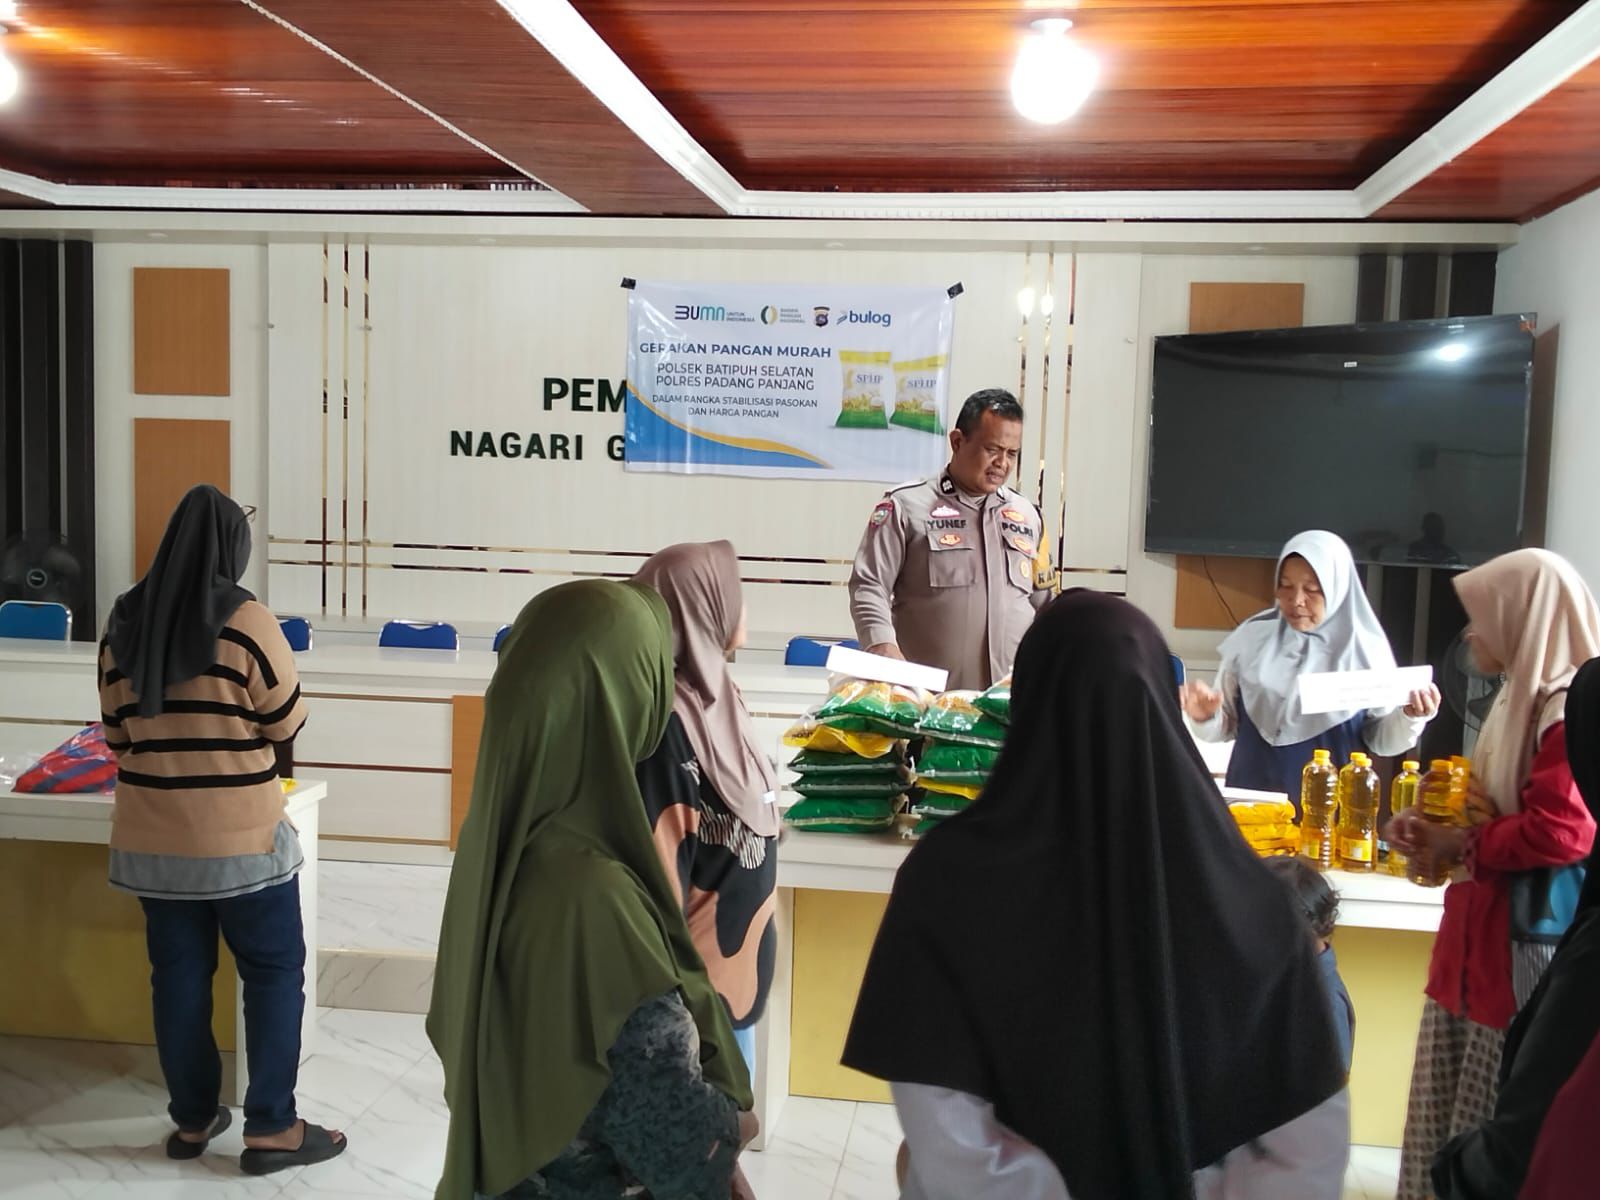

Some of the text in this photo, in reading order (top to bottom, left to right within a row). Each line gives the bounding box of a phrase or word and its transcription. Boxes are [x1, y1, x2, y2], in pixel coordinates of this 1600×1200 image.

[849, 310, 892, 327] bulog
[639, 343, 831, 358] GERAKAN PANGAN MURAH
[657, 363, 814, 378] POLSEK BATIPUH SELATAN
[656, 375, 814, 391] POLRES PADANG PANJANG
[652, 394, 818, 408] DALAM RANGKA STABILISASI PASOKAN
[688, 407, 779, 419] DAN HARGA PANGAN
[450, 430, 583, 460] NAGARI
[928, 519, 967, 530] YUNEF
[1001, 521, 1034, 538] POLRI
